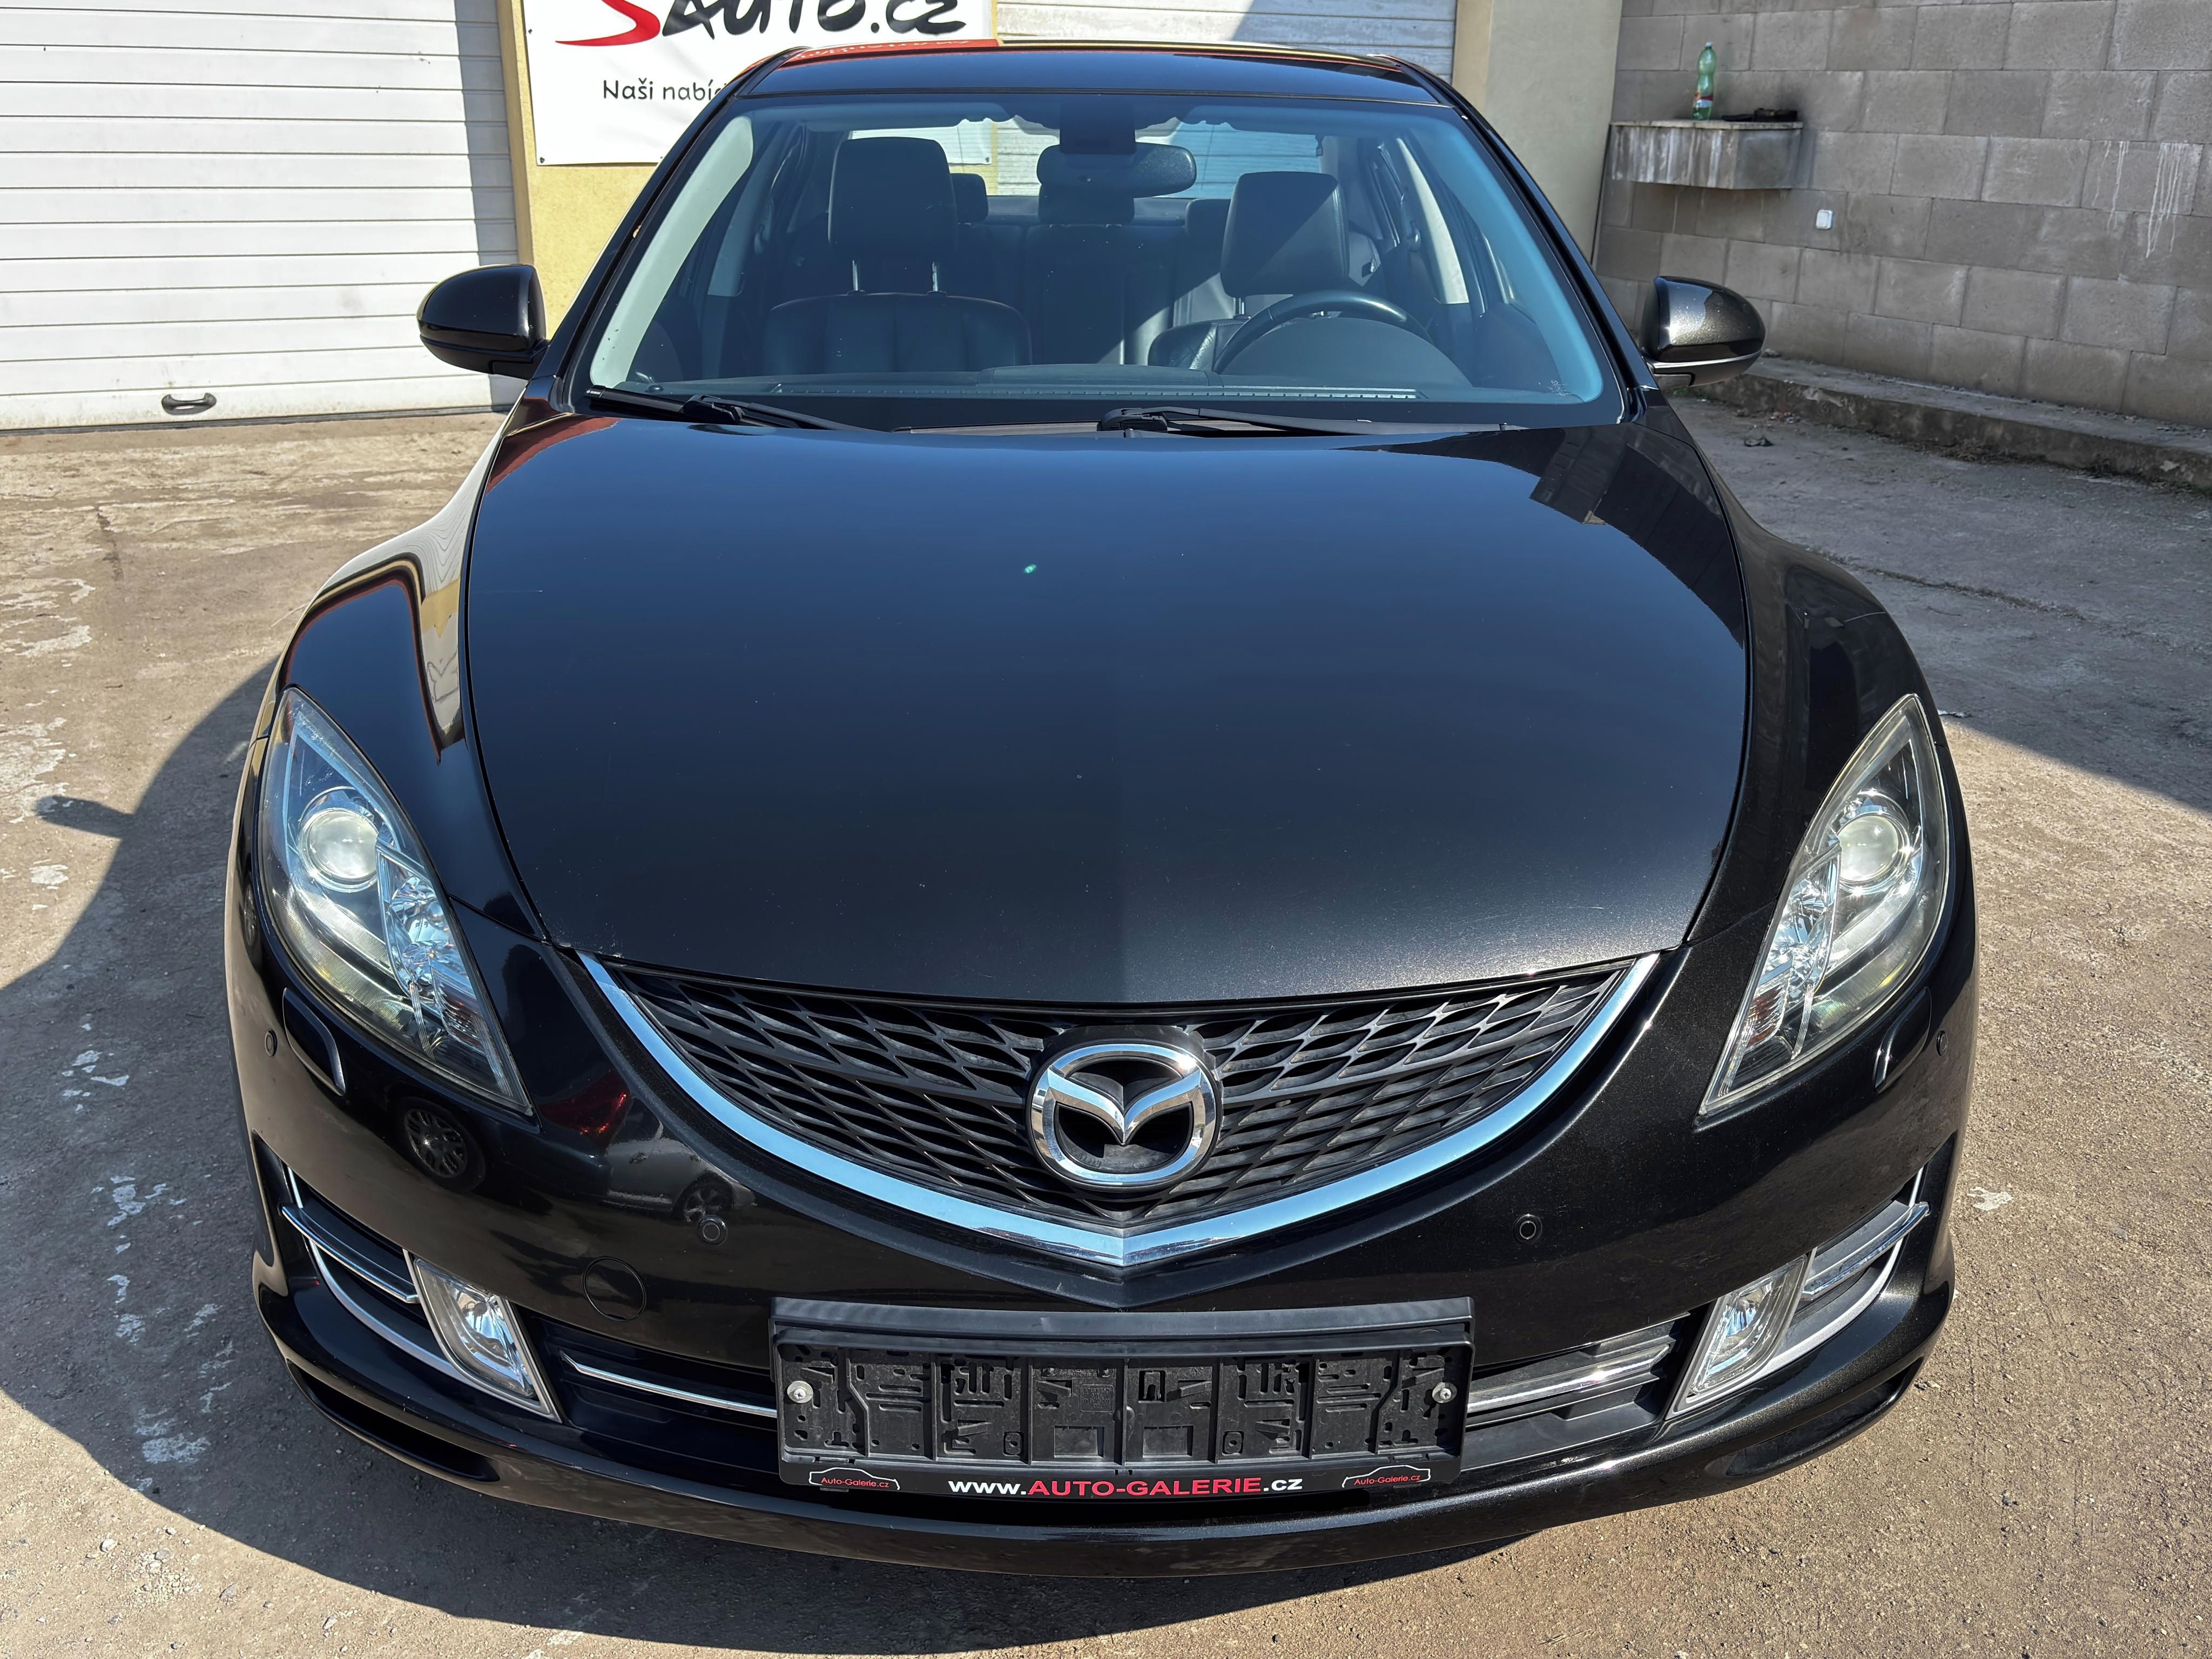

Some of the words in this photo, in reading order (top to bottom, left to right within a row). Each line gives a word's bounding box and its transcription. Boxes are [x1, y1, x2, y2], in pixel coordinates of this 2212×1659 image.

[603, 77, 653, 100] Naši
[821, 1477, 889, 1488] Auto-Galerie.cz
[948, 1478, 1303, 1496] www.AUTO-GALERIE.cz
[1354, 1475, 1421, 1485] Auto-Galerie.cz
